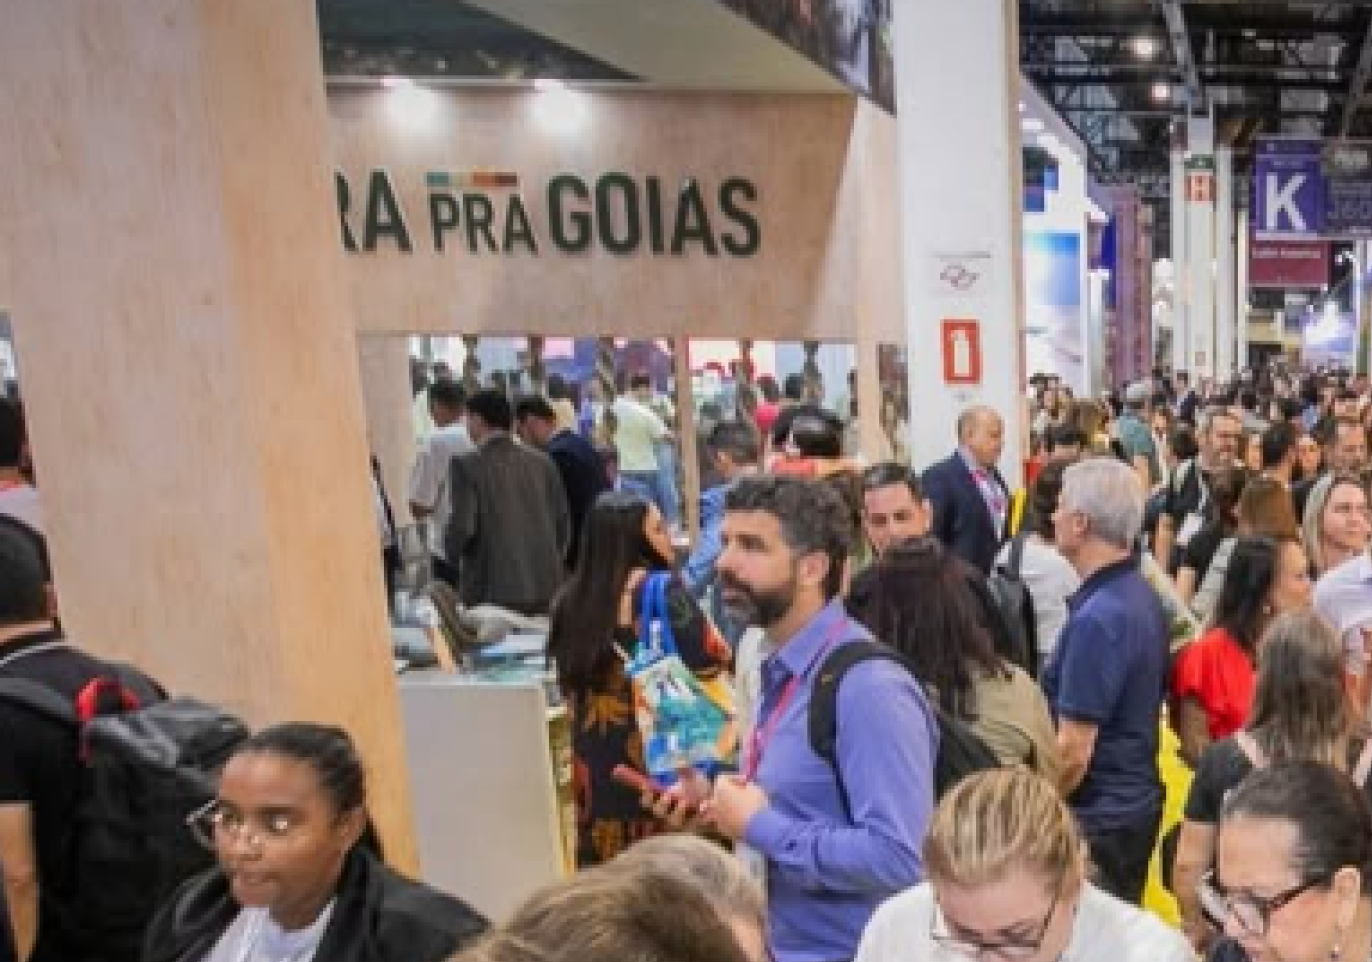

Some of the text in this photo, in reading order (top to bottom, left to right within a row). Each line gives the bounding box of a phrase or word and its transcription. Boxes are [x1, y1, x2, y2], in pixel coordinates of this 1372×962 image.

[427, 193, 539, 254] PRA
[545, 172, 762, 257] GOIAS
[1266, 171, 1307, 230] K
